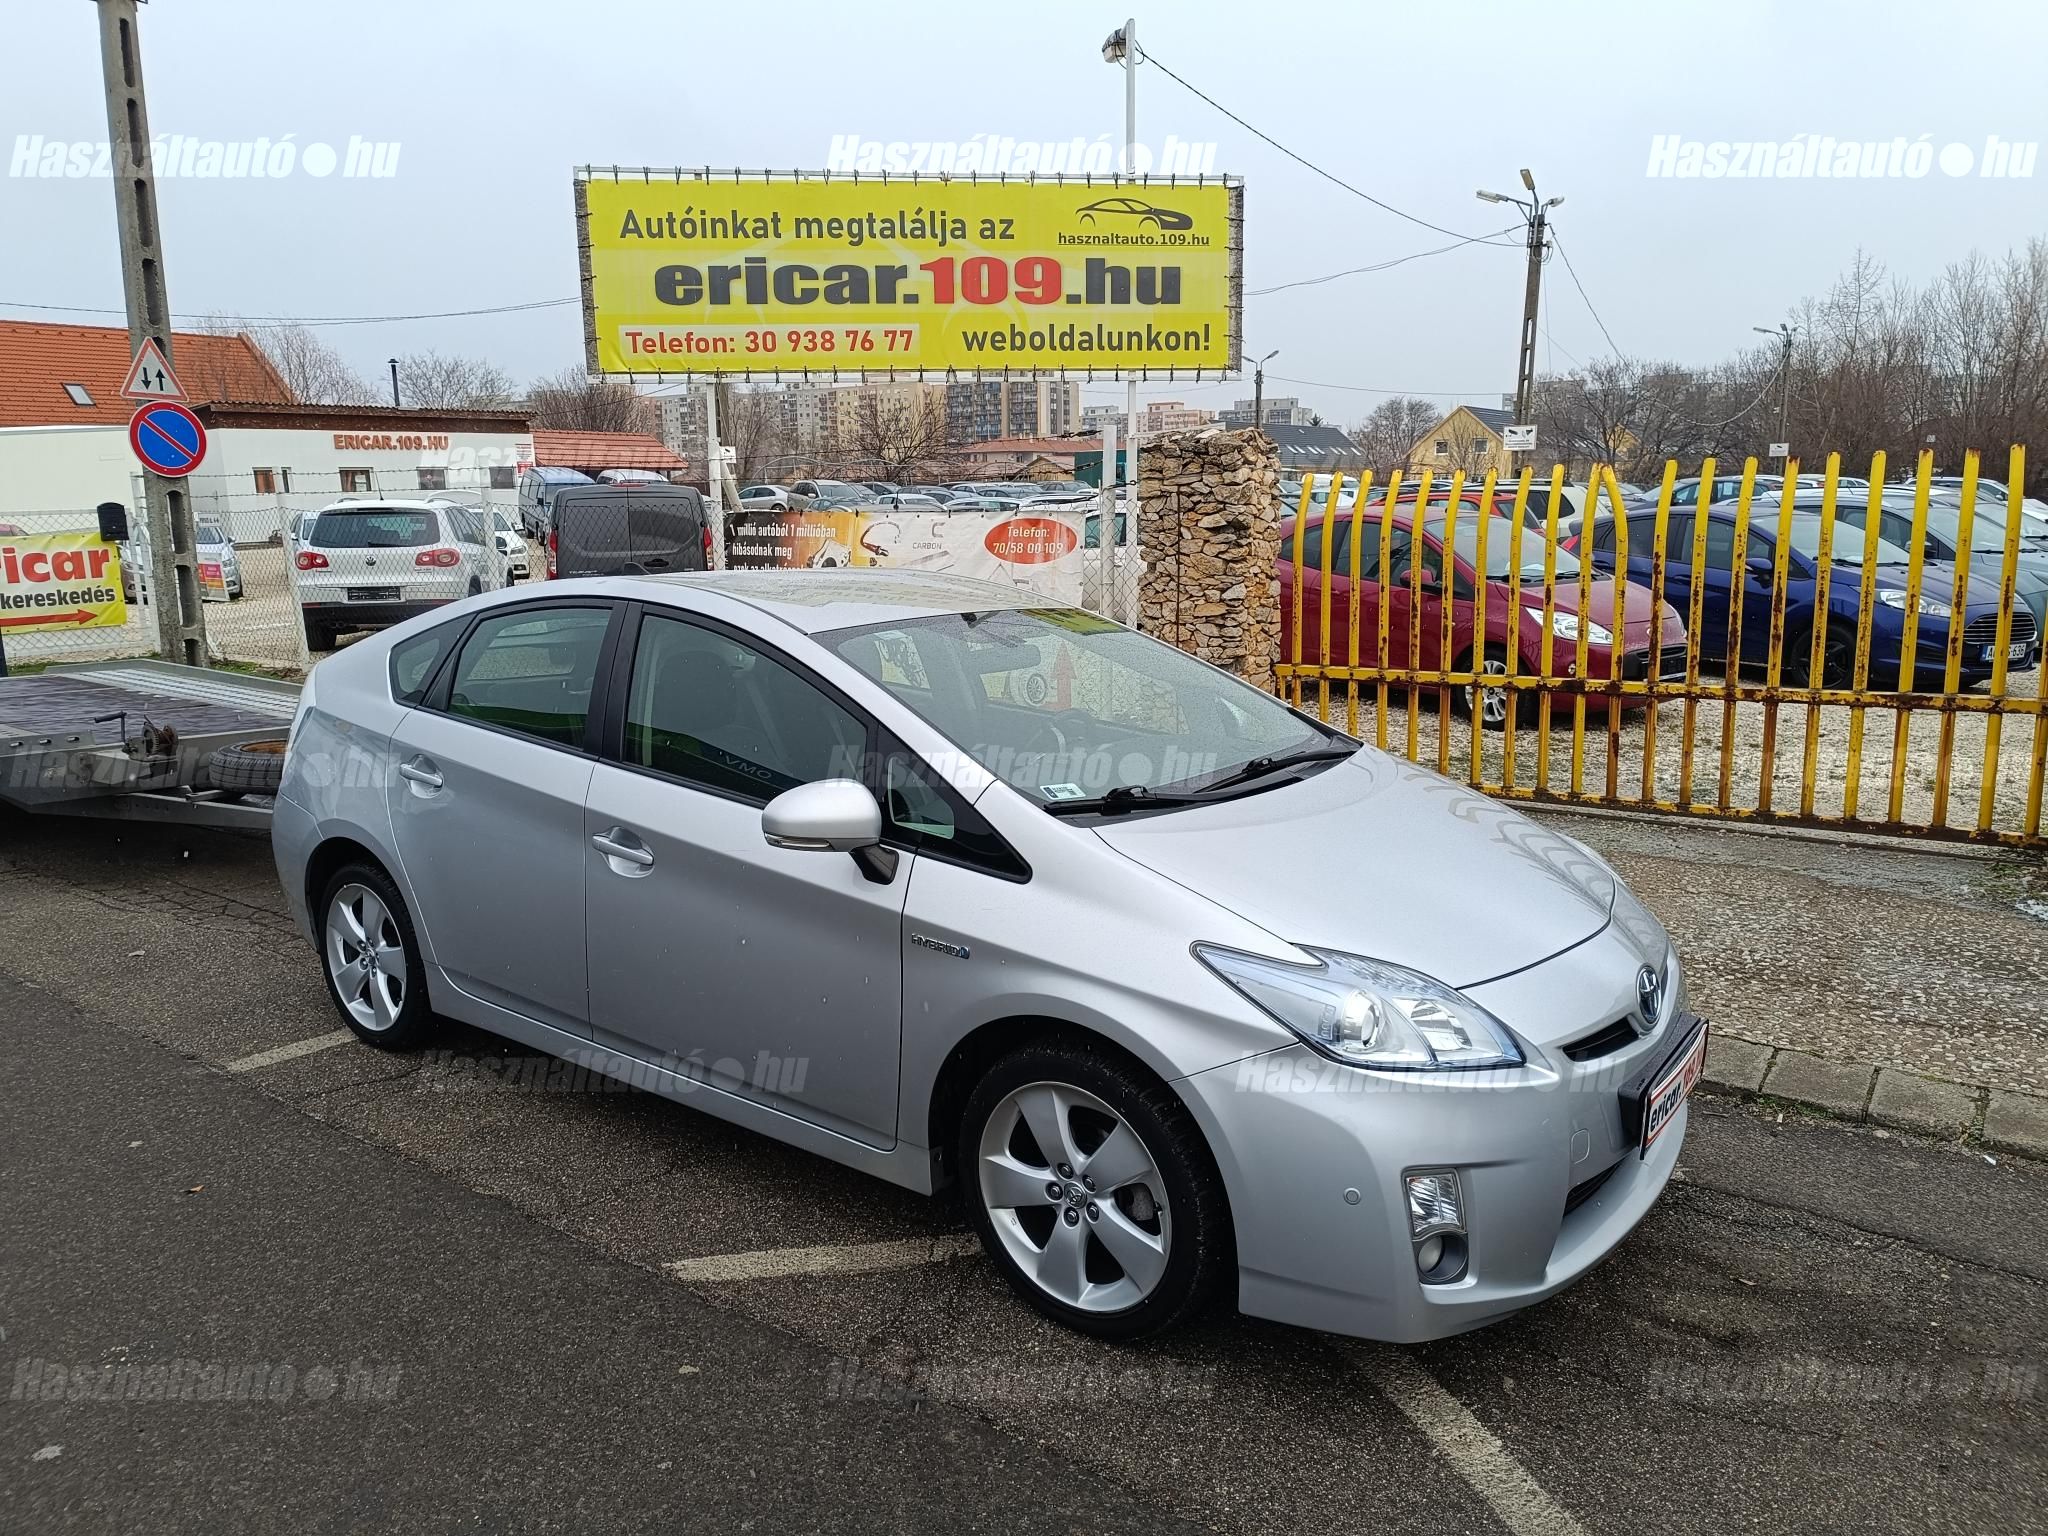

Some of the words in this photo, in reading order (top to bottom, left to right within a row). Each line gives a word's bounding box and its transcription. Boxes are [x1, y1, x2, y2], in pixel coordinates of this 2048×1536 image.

[620, 206, 781, 239] Autóinkat
[794, 207, 967, 247] megtalálja
[979, 218, 1015, 240] az
[1058, 232, 1210, 246] hasznaltauto.109.hu
[655, 257, 1181, 306] ericar.109.hu
[625, 331, 735, 353] Telefon:
[745, 331, 777, 352] 30
[787, 330, 835, 352] 938
[845, 330, 874, 351] 76
[883, 330, 913, 351] 77
[962, 323, 1210, 352] weboldalunkon!
[333, 434, 449, 450] ERICAR.109.HU
[758, 523, 788, 537] autóból
[790, 524, 795, 537] 1
[796, 524, 836, 538] millióban
[1007, 526, 1050, 538] Telefon:
[732, 541, 773, 557] hibásodnak
[774, 546, 793, 559] meg
[912, 542, 942, 550] CARBON
[993, 542, 1023, 555] 70/58
[1027, 542, 1041, 554] 00
[1044, 542, 1064, 554] 109
[0, 547, 110, 584] icar
[0, 584, 116, 610] kereskedés
[911, 933, 961, 957] HYBRID
